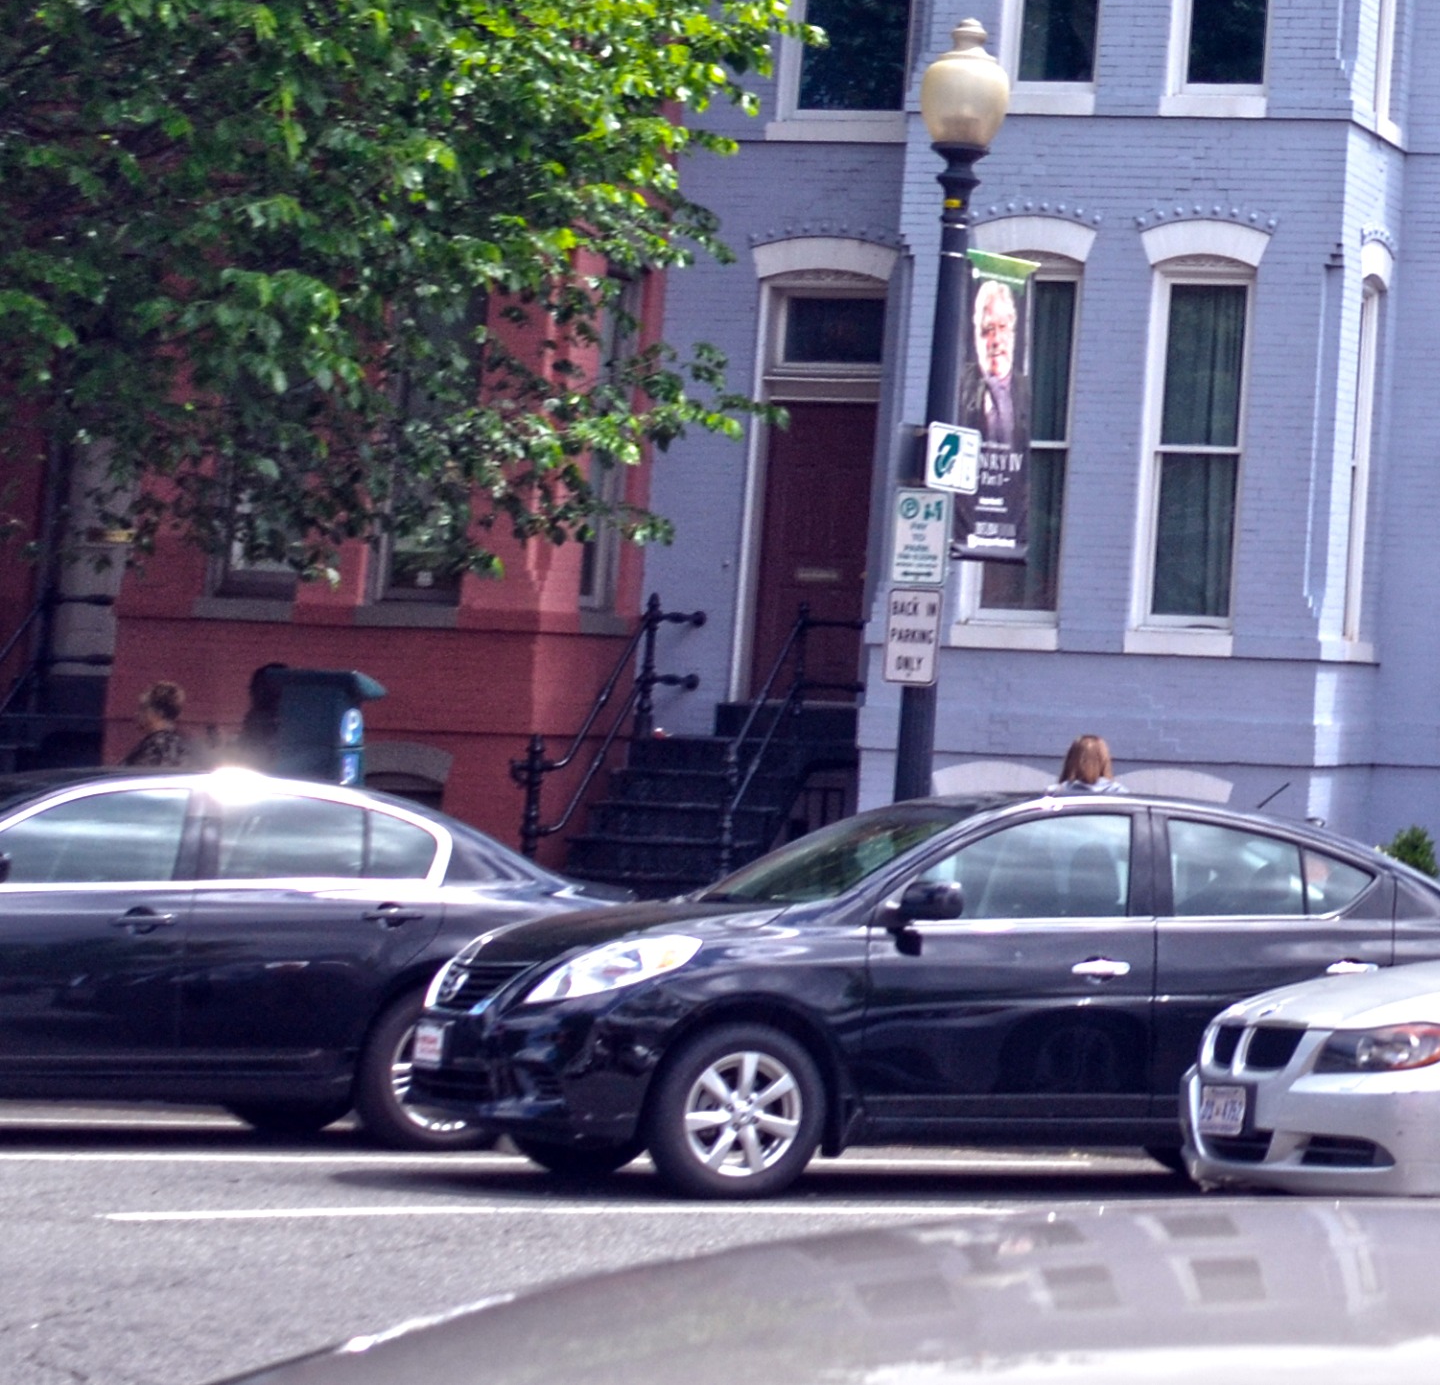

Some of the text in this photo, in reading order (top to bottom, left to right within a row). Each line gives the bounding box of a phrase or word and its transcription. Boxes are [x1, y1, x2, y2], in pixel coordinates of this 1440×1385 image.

[892, 601, 937, 617] BACK IN
[890, 627, 934, 645] PARKING
[896, 655, 925, 672] ONLY
